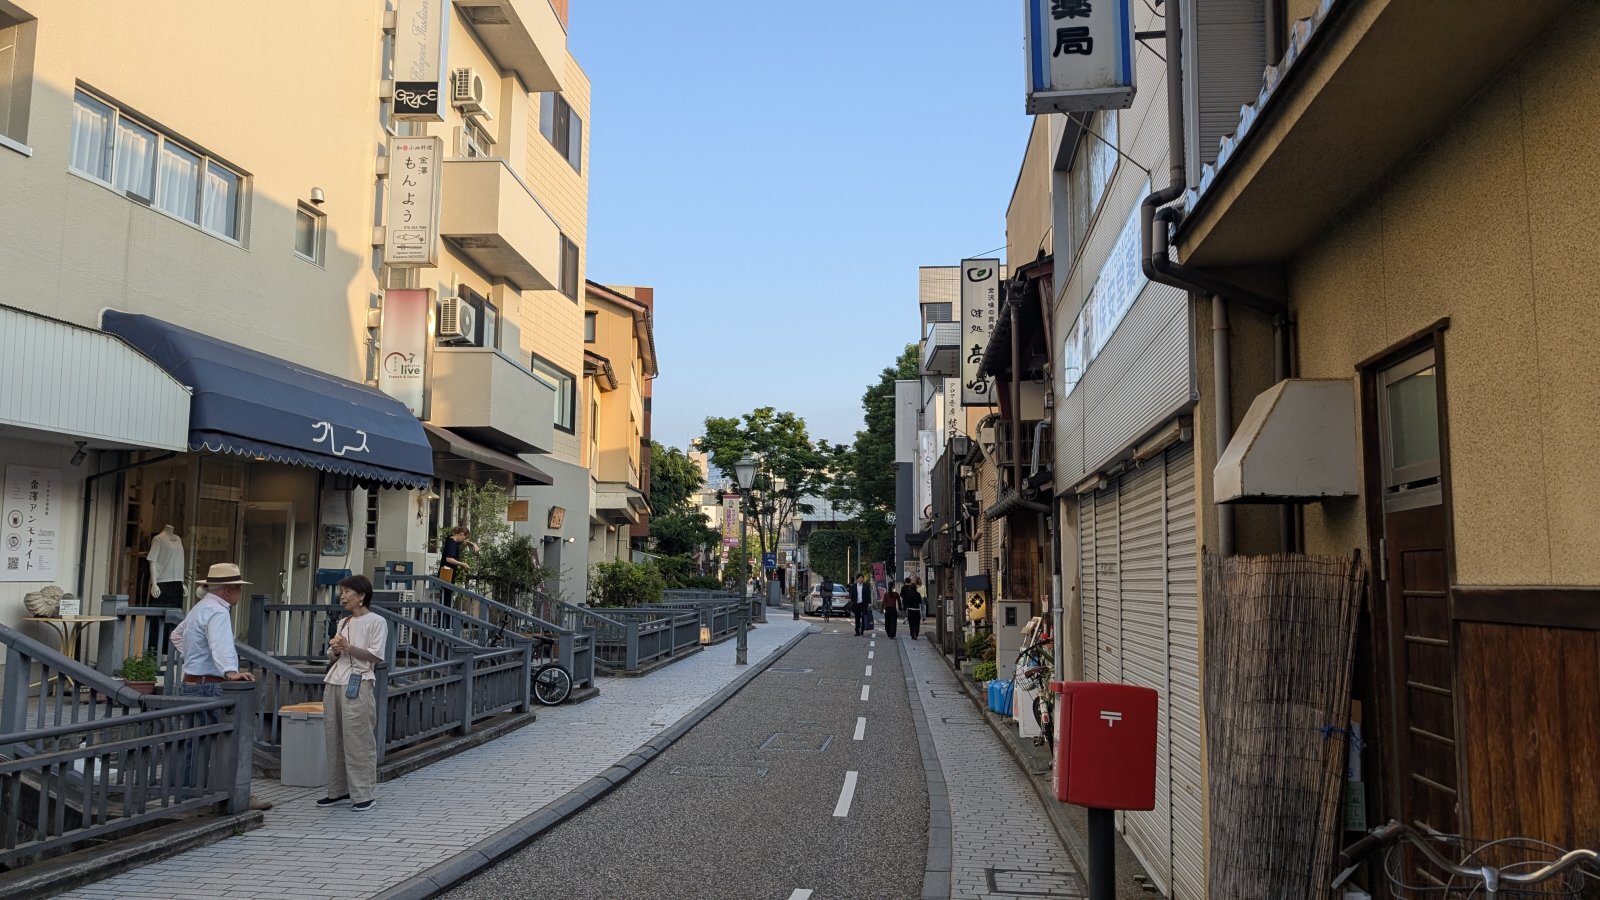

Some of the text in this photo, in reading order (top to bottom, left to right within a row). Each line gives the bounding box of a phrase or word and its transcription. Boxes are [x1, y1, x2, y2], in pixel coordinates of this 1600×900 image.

[411, 1, 429, 41] Fashion
[1051, 0, 1094, 58] 薬局
[409, 42, 431, 81] Elegant
[395, 89, 438, 109] GRACE
[402, 156, 417, 223] もんよう
[25, 479, 40, 572] 金澤アンモナイト
